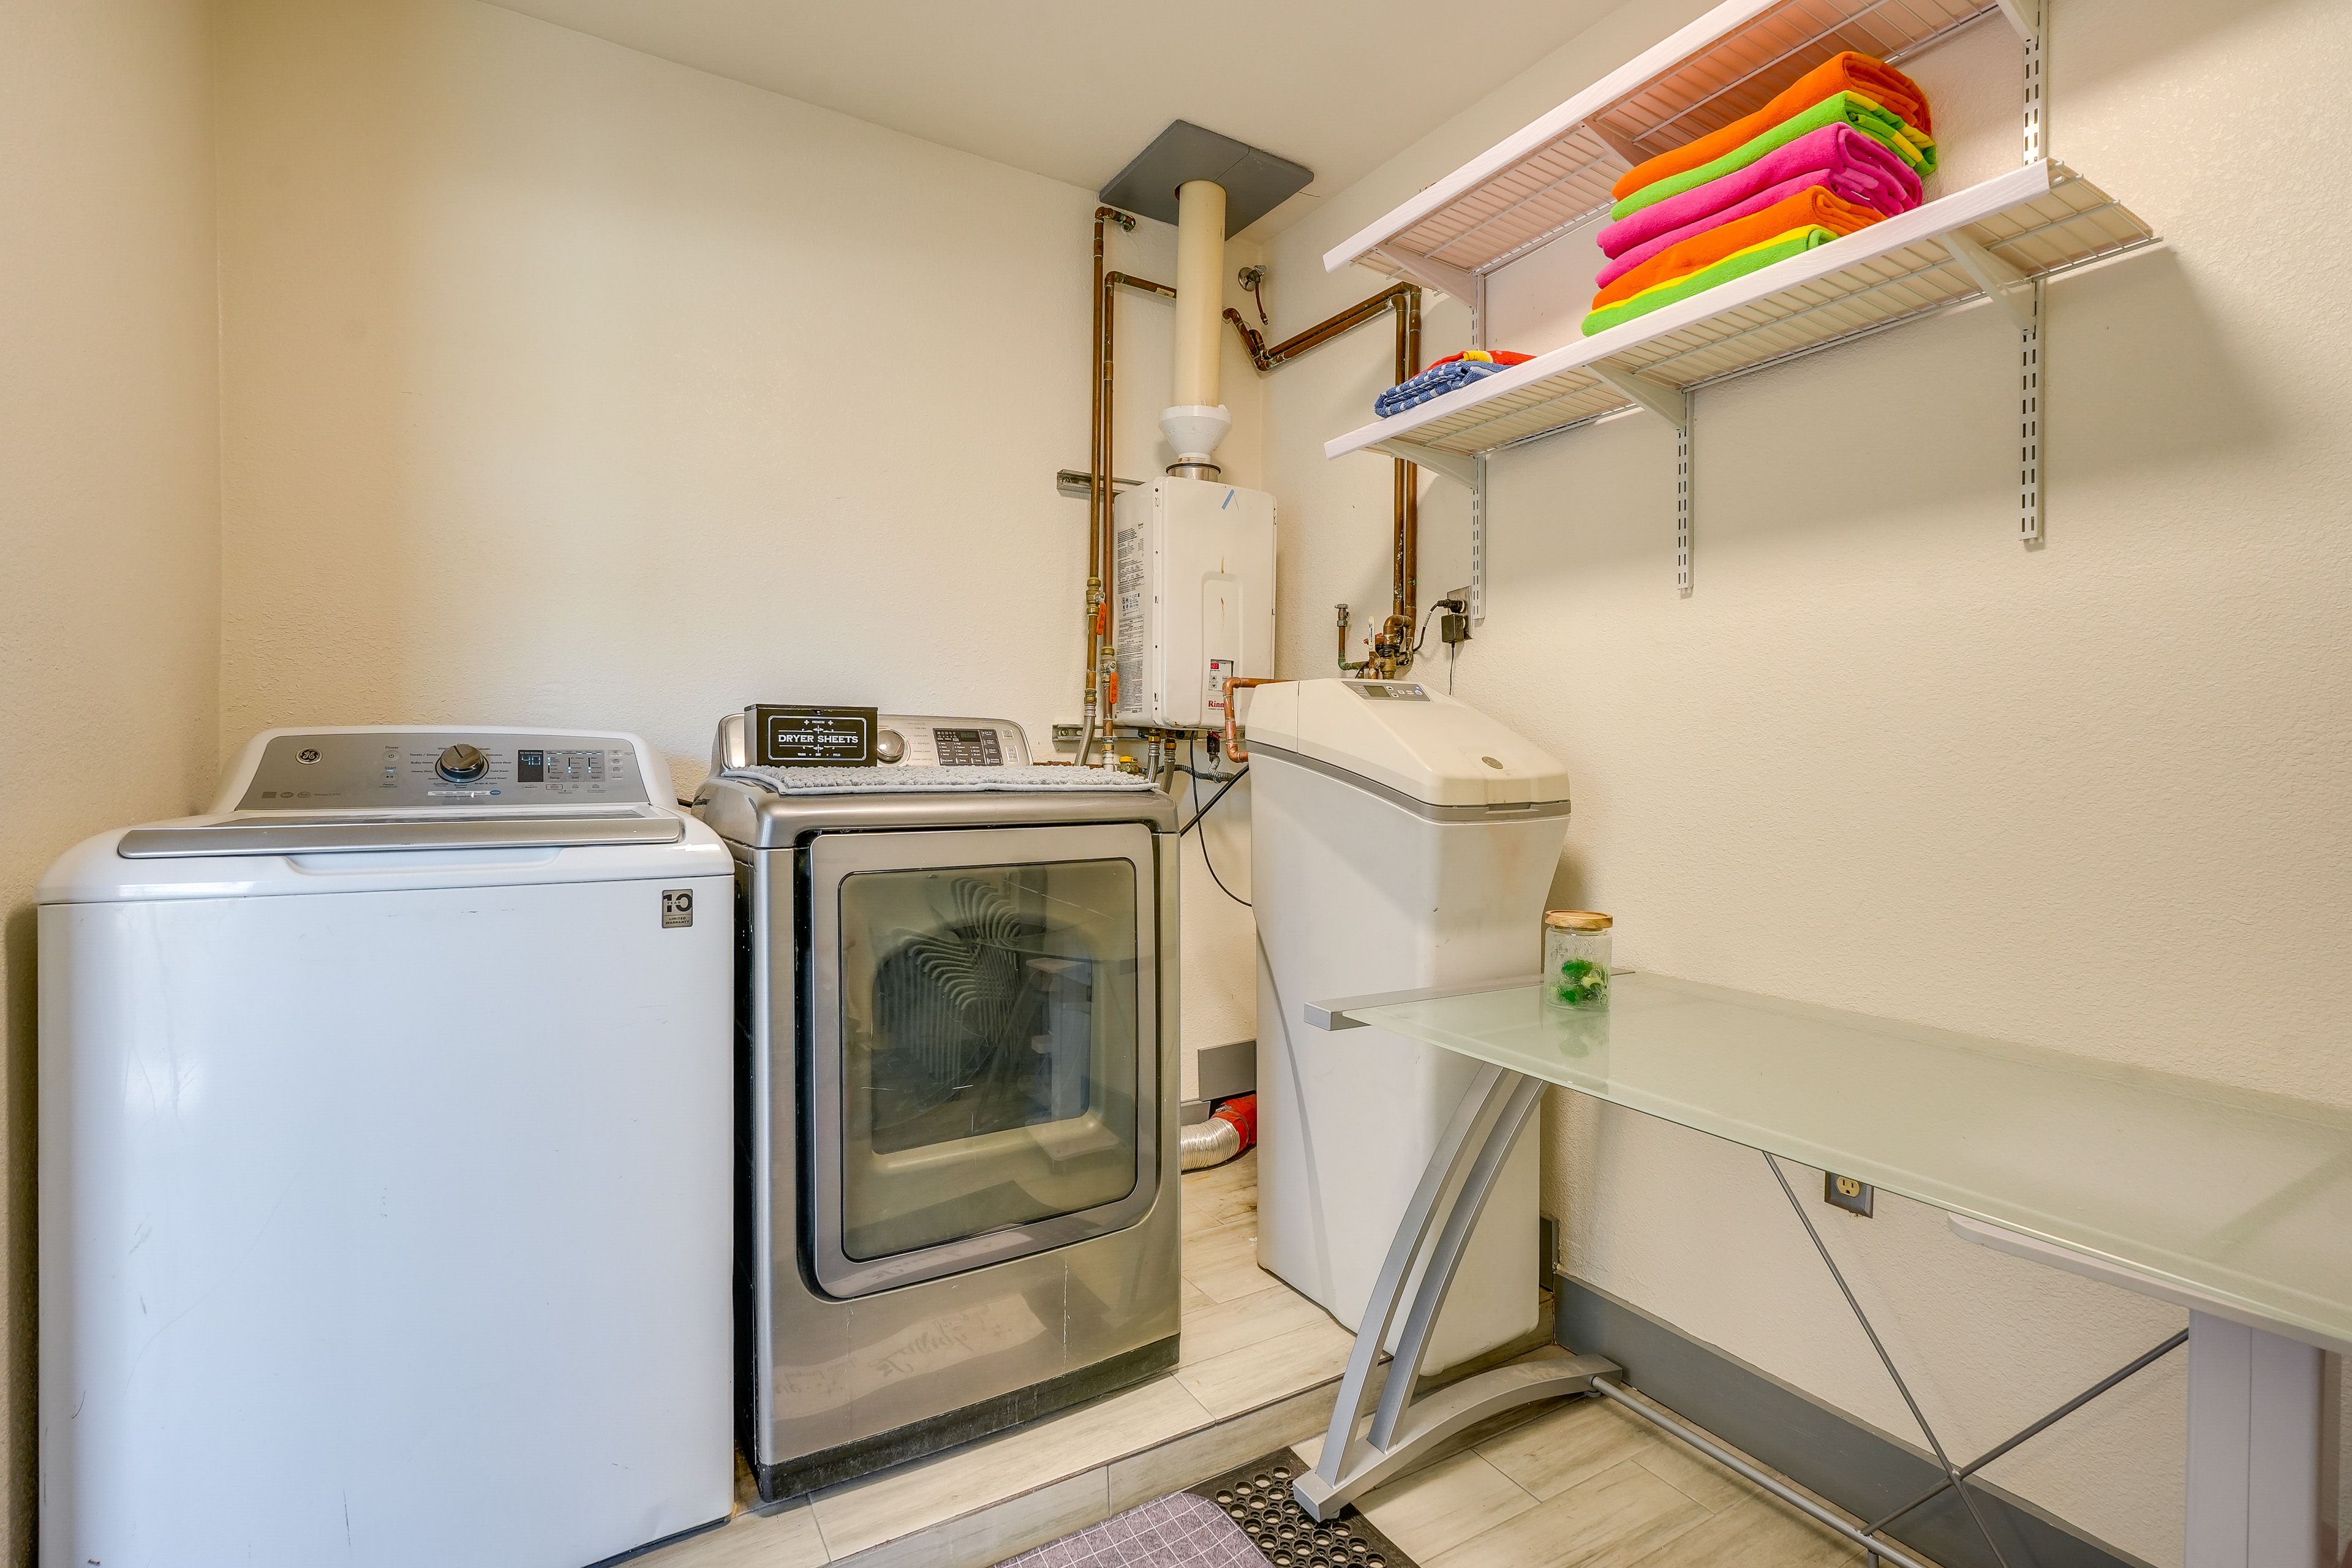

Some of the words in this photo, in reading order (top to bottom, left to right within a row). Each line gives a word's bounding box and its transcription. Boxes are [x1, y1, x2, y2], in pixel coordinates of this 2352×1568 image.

[778, 734, 815, 743] DRYER
[521, 755, 541, 765] 40
[663, 893, 693, 912] 10
